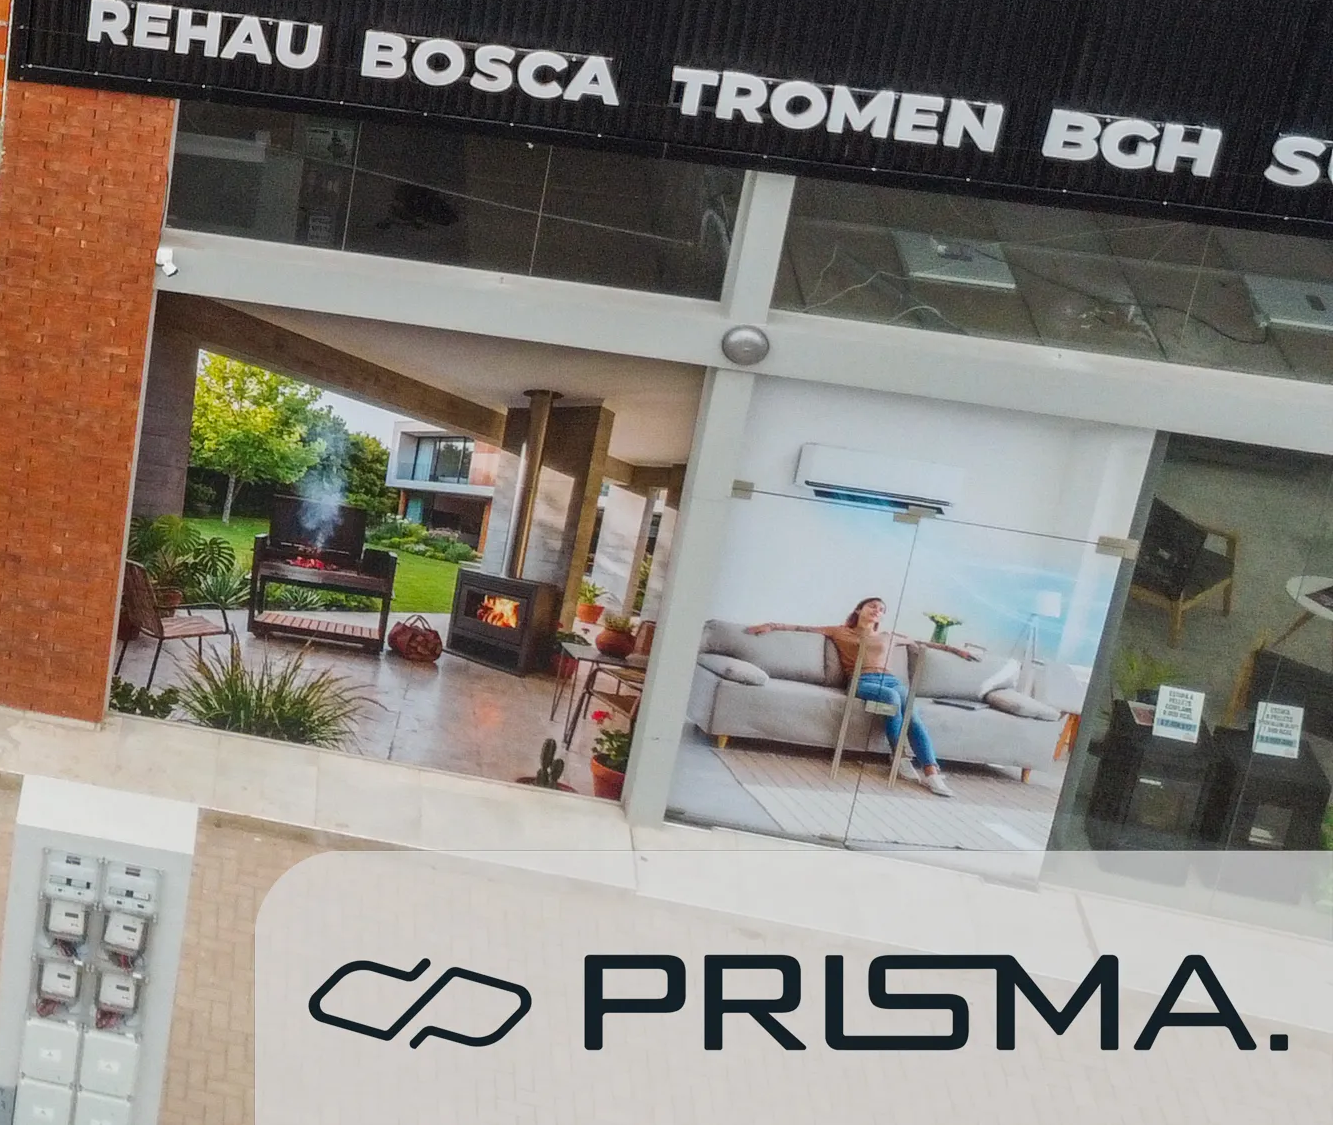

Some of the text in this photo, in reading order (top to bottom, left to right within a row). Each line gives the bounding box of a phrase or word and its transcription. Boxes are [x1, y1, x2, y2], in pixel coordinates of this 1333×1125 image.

[361, 29, 620, 106] BOSCA
[672, 65, 1004, 153] TROMEN
[1041, 109, 1222, 178] BGH
[1263, 135, 1333, 187] S
